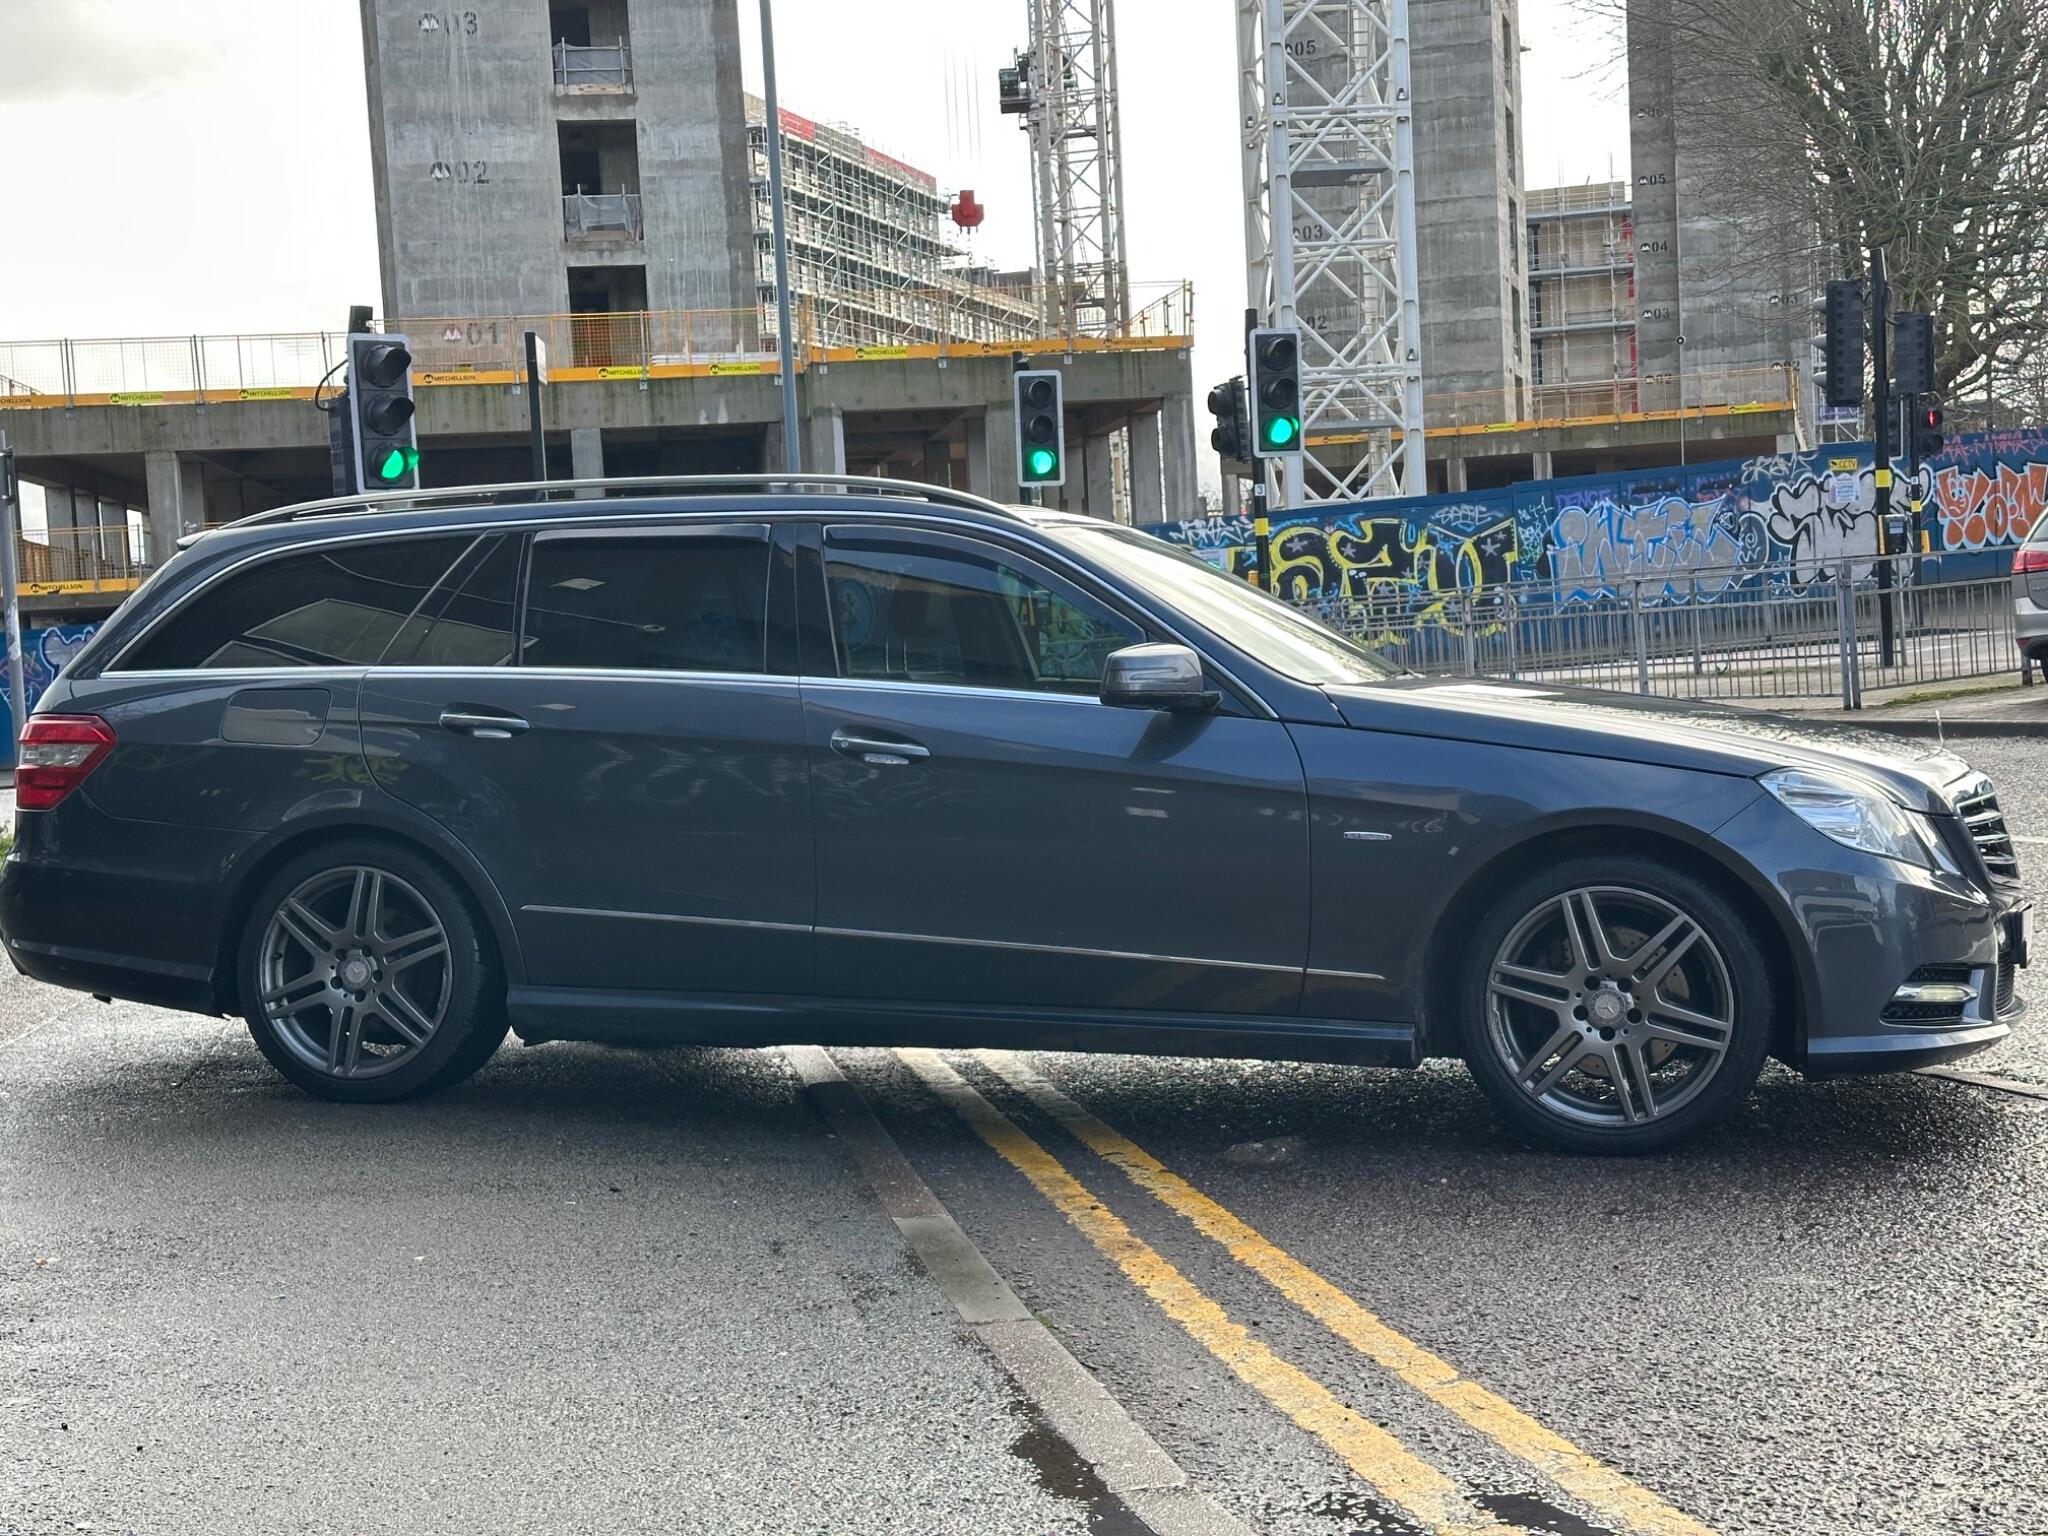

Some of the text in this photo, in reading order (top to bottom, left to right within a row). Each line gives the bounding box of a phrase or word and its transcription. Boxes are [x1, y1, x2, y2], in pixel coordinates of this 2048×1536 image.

[443, 11, 477, 35] 03
[1295, 40, 1316, 57] 05
[455, 160, 489, 184] 02
[1650, 173, 1666, 186] 05
[1302, 224, 1323, 240] 03
[1652, 240, 1667, 252] 04
[1782, 294, 1798, 305] 03
[1654, 308, 1670, 319] 03
[1306, 315, 1327, 330] 02
[466, 322, 497, 345] 01
[1839, 460, 1856, 468] CCTV
[1256, 485, 1263, 495] 3
